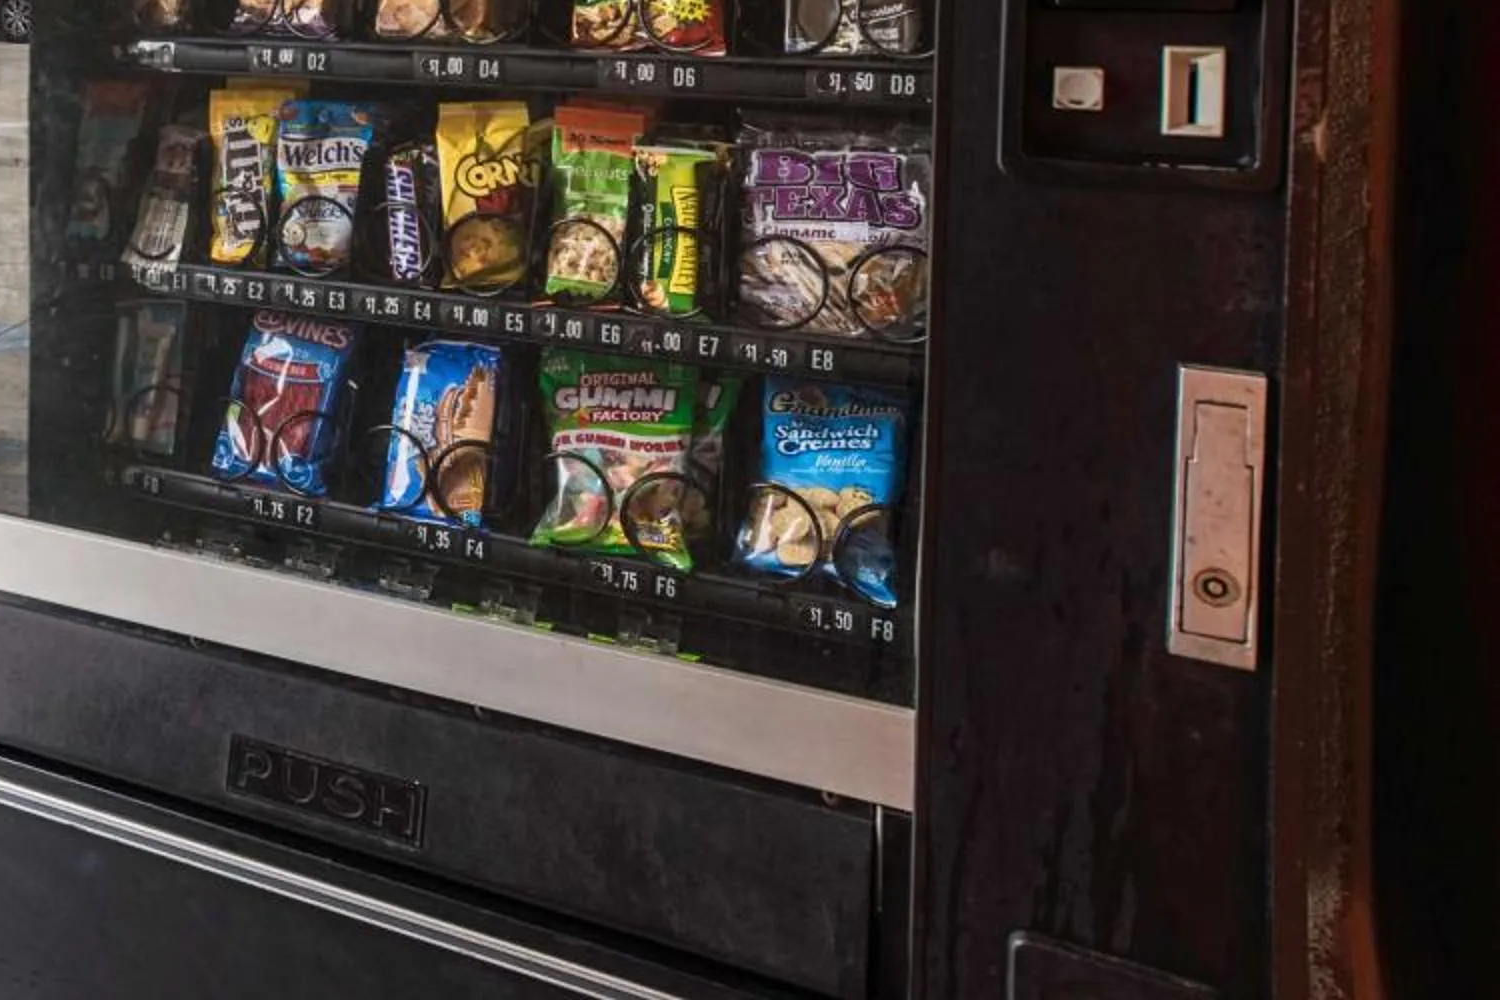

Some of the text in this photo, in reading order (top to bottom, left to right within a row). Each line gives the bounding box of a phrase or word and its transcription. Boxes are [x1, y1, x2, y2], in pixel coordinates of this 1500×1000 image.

[307, 52, 326, 72] D2
[478, 58, 500, 79] D4
[672, 66, 696, 88] D6
[890, 73, 915, 96] D8
[283, 140, 365, 167] Welch's
[754, 150, 904, 193] BIG
[744, 184, 922, 231] TEXAS
[762, 227, 838, 241] Cinnamo
[249, 280, 265, 300] E2
[329, 291, 346, 310] E3
[414, 301, 432, 321] E4
[505, 312, 524, 332] E5
[283, 316, 350, 350] VINES
[601, 324, 621, 346] E6
[700, 336, 719, 358] E7
[812, 349, 834, 371] E8
[579, 371, 657, 388] ORIGINAL
[555, 385, 678, 412] GUMMI
[591, 410, 664, 424] FACTORY
[575, 432, 627, 450] GUMMI
[775, 422, 879, 441] Sandwich
[776, 437, 873, 456] Cremes
[297, 504, 314, 525] F2
[465, 538, 485, 560] F4
[656, 576, 677, 598] F6
[871, 619, 894, 643] F8
[236, 751, 416, 837] PUSH
